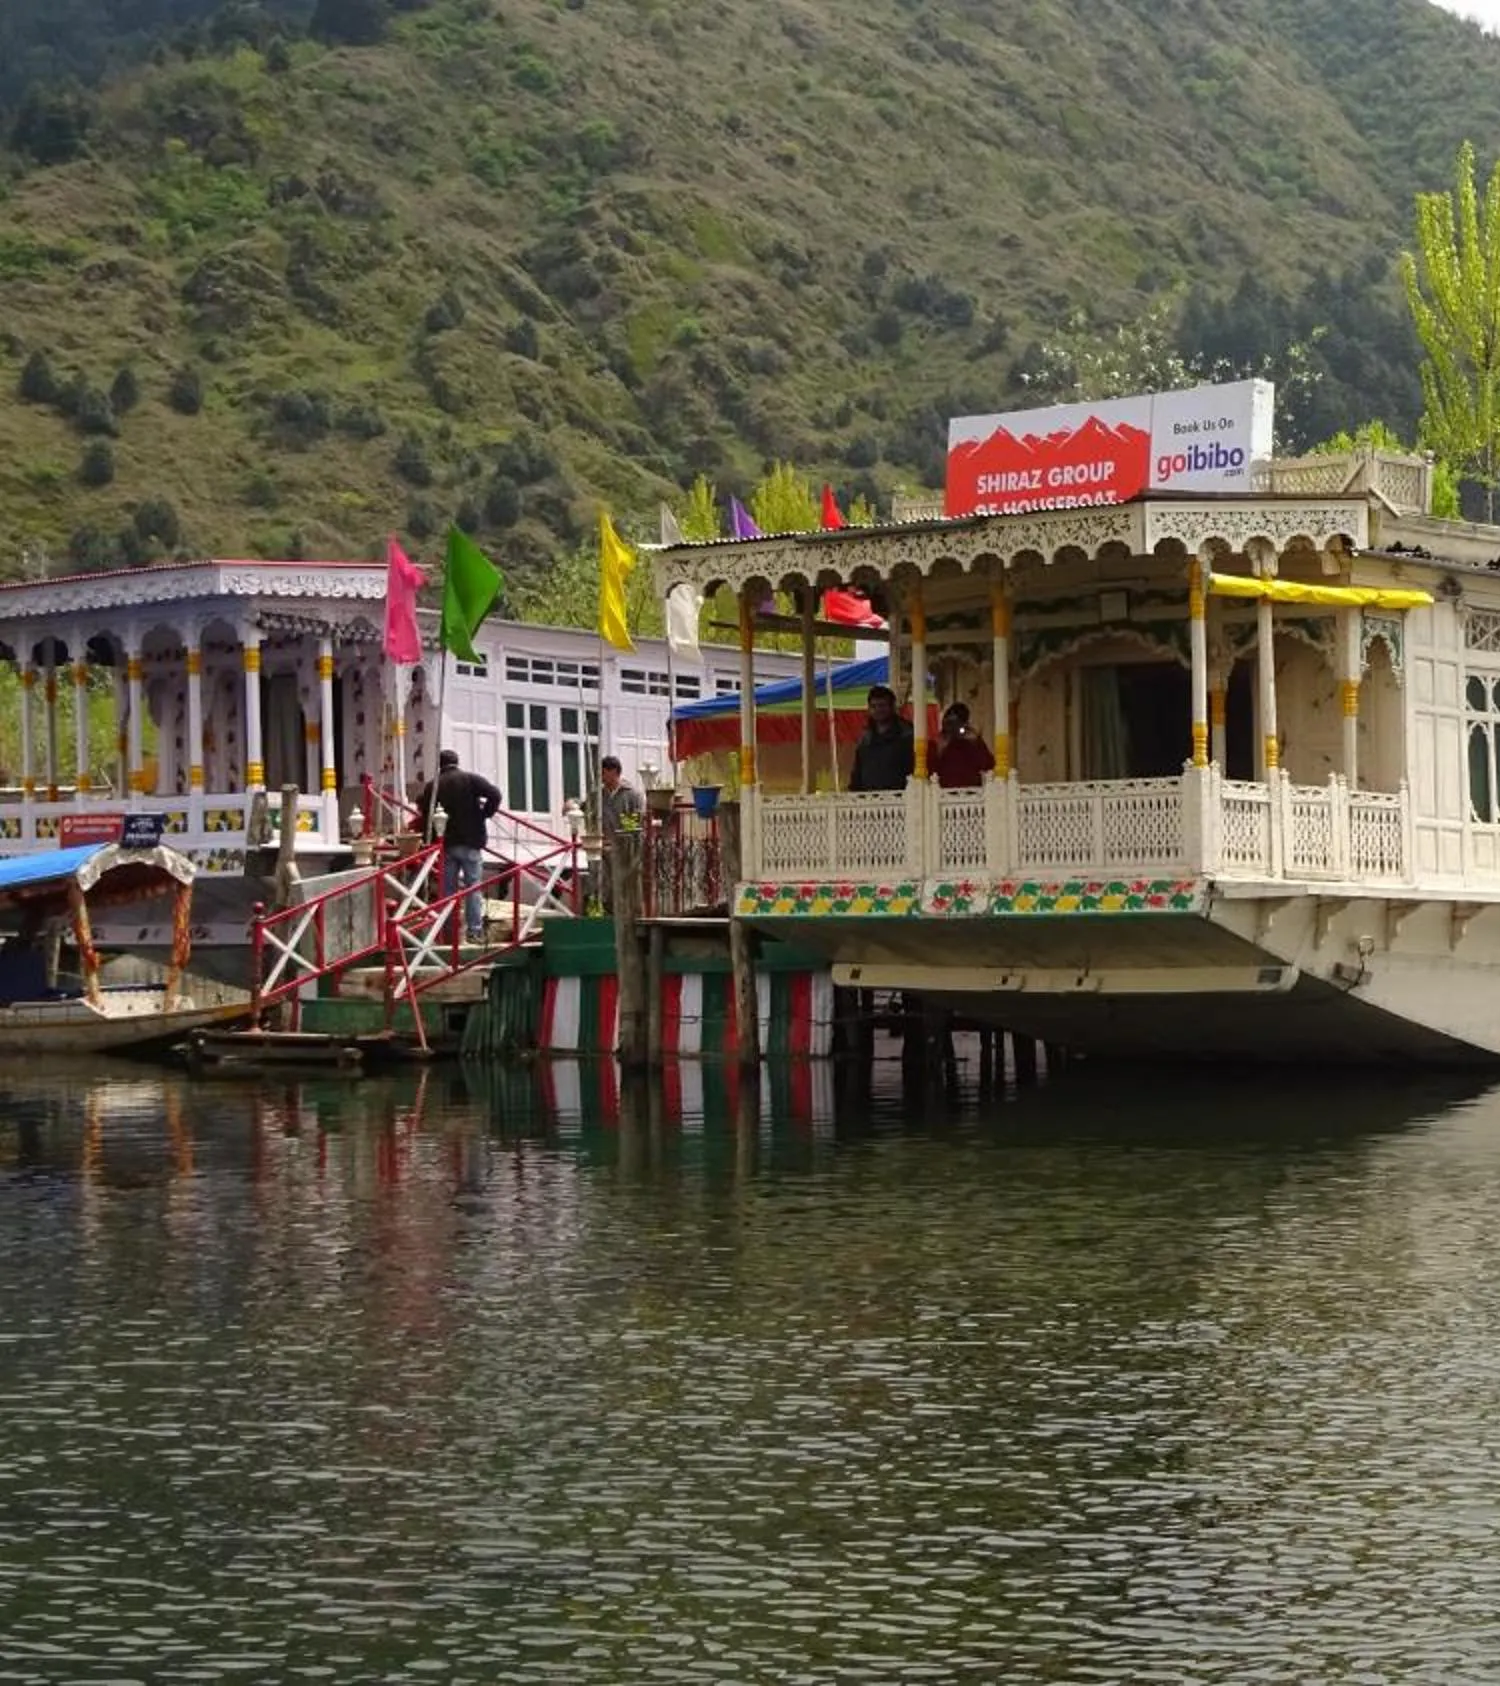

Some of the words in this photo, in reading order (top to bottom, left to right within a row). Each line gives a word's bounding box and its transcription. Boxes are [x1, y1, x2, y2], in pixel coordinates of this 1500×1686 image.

[1173, 422, 1199, 435] Book
[1203, 420, 1216, 432] Us
[1218, 418, 1234, 430] On
[977, 469, 1043, 495] SHIRAZ
[1047, 461, 1115, 486] GROUP
[1157, 441, 1244, 482] goibibo
